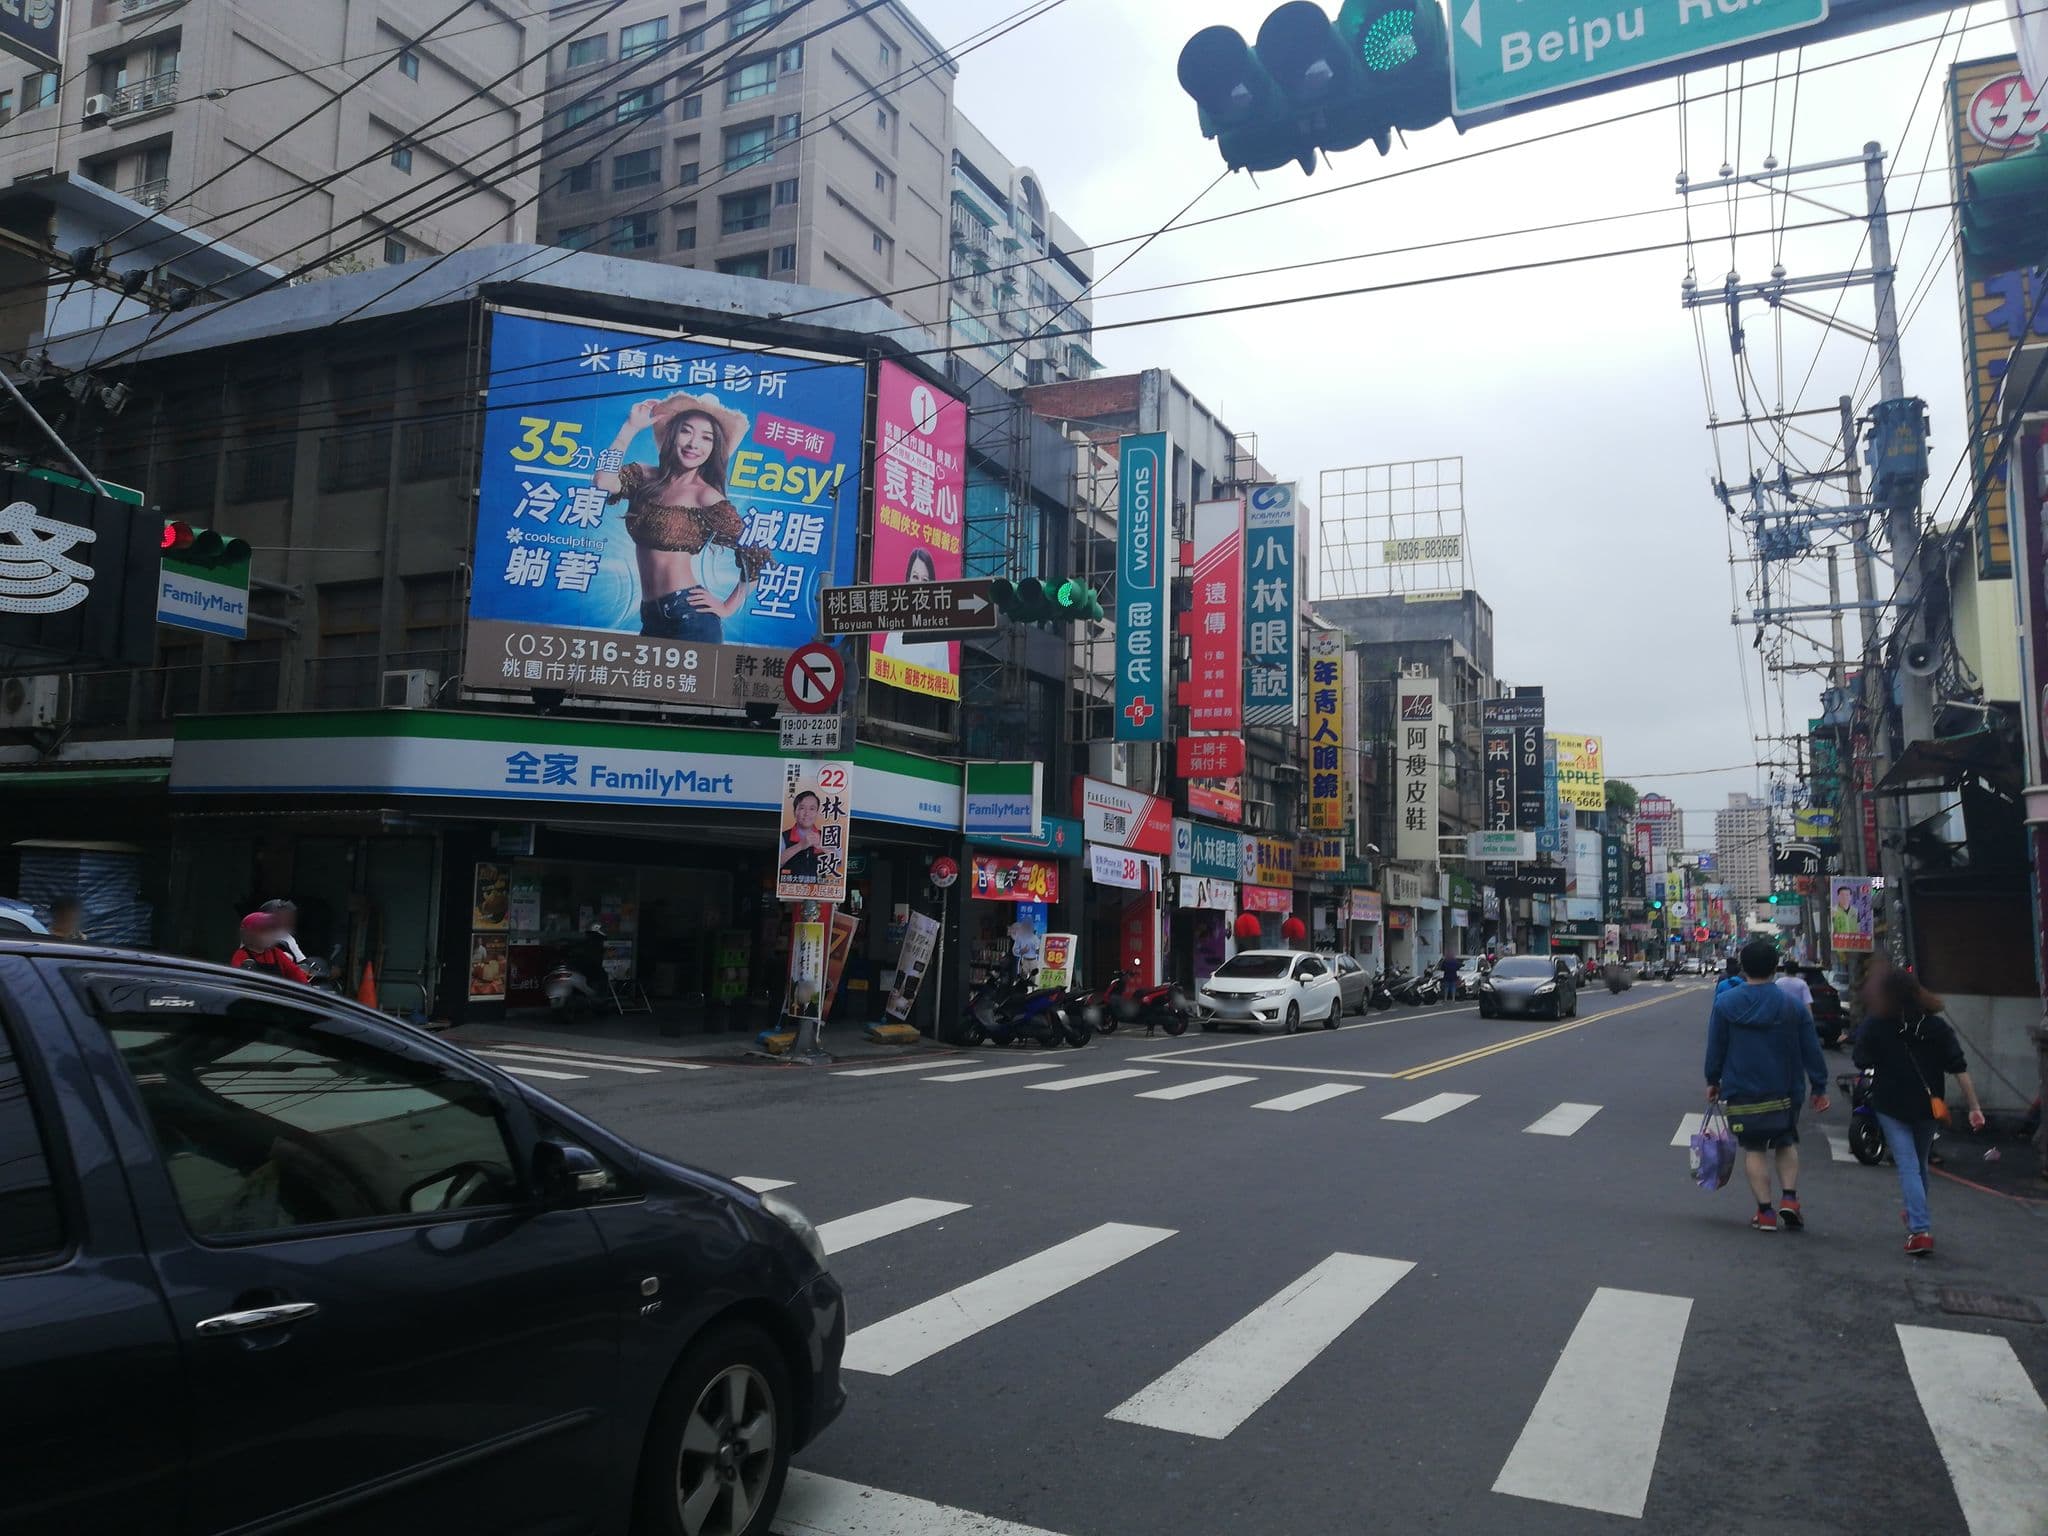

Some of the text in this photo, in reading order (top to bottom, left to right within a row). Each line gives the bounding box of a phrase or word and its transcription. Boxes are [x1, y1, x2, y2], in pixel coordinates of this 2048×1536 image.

[1501, 7, 1645, 73] Beipu
[579, 343, 787, 398] 米蘭時尚診所
[510, 416, 623, 474] 35分鐘
[764, 420, 824, 455] 非手術
[730, 450, 846, 505] Easy!
[884, 458, 958, 525] 袁慧心
[513, 481, 610, 530] 冷凍
[1133, 467, 1149, 571] watsons
[524, 532, 605, 551] coolsculpting
[738, 506, 825, 555] 減脂
[504, 546, 599, 593] 躺著
[751, 560, 804, 619] 塑
[162, 583, 244, 616] FamilyMart
[828, 587, 952, 616] 桃園觀光夜市
[1203, 582, 1228, 635] 遠傳
[1250, 535, 1289, 697] 小林眼鏡
[832, 615, 949, 631] Taoyuan Night Market
[1128, 601, 1153, 683] 屈臣氏
[505, 633, 699, 670] (03)316-3198
[502, 658, 697, 693] 桃園市新埔六街85號
[782, 733, 838, 747] 禁止右轉
[783, 719, 838, 731] 19:00-22:00
[1190, 742, 1228, 756] 上網卡
[1190, 757, 1228, 771] 預付卡
[506, 751, 734, 797] 全家 FamilyMart
[820, 769, 844, 788] 22
[1405, 727, 1428, 832] 阿瘦皮鞋
[1558, 770, 1600, 785] APPLE
[968, 803, 1031, 818] FamilyMart
[817, 796, 846, 878] 林國政
[1192, 834, 1237, 869] 小林眼鏡
[1122, 858, 1136, 880] 38
